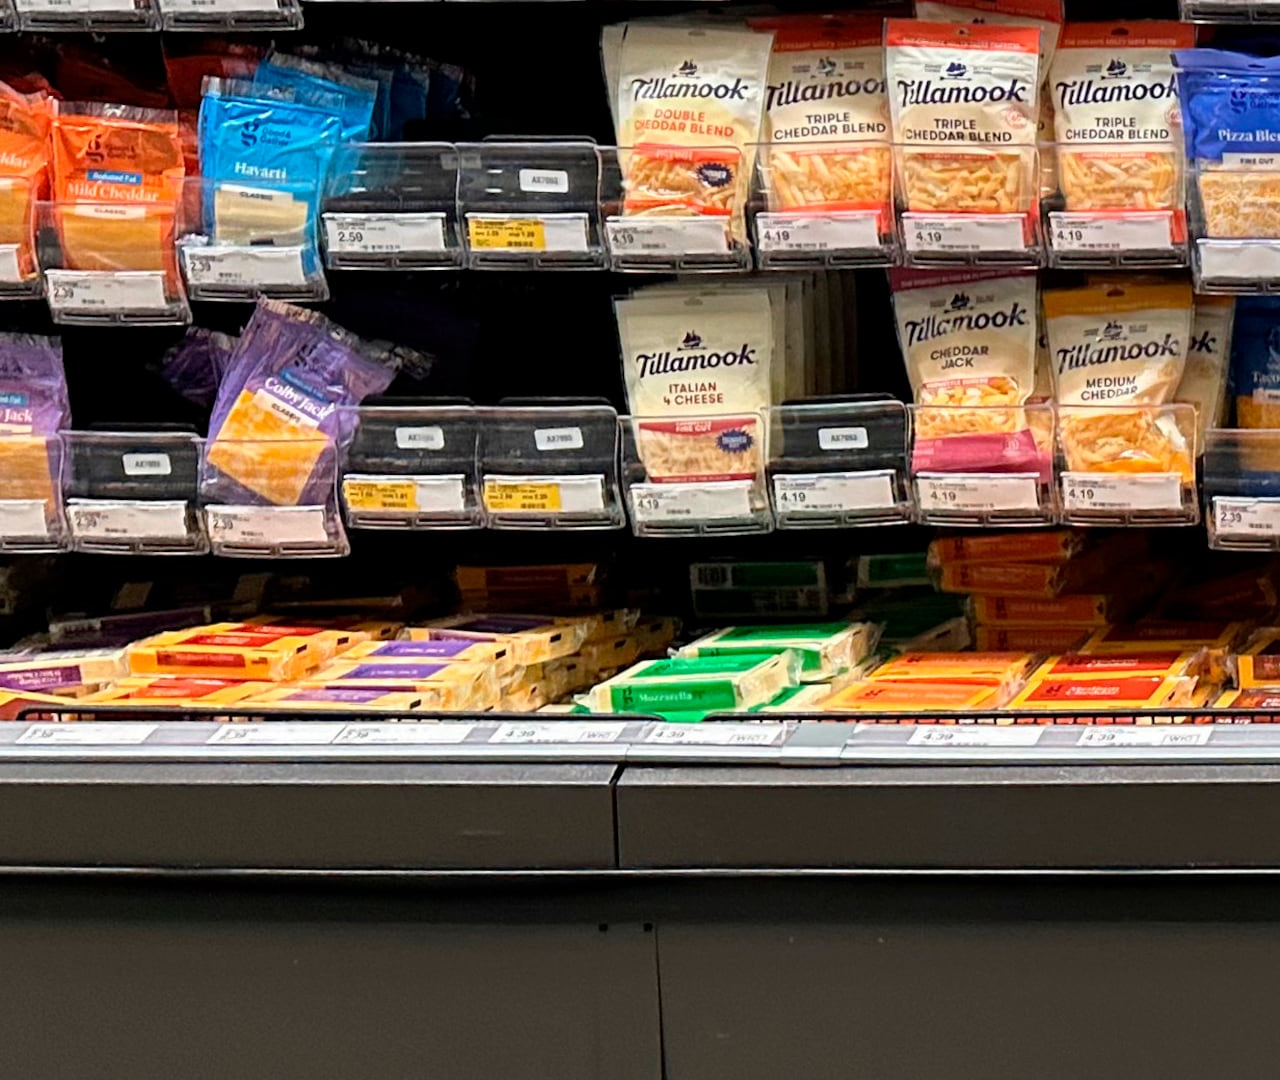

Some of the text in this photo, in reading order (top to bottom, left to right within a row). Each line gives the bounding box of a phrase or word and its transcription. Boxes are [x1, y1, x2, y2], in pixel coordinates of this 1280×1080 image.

[632, 77, 748, 101] Tillamook
[897, 79, 1026, 108] Tillamook
[1056, 76, 1179, 106] Tillamook
[653, 109, 706, 122] DOUBLE
[805, 112, 850, 125] TRIPLE
[935, 118, 976, 130] TRIPLE
[1094, 117, 1137, 129] TRIPLE
[773, 122, 887, 139] CHEDDAR BLEND
[905, 129, 1012, 143] CHEDDAR BLEND
[1066, 127, 1169, 140] CHEDDAR BLEND
[1217, 129, 1253, 144] Pizza
[235, 161, 288, 180] Havarti
[68, 183, 160, 202] Mild Cheddar
[337, 230, 364, 244] 2.59
[916, 229, 942, 243] 4.19
[1056, 229, 1082, 242] 4.19
[905, 303, 1027, 345] Tillamook
[930, 345, 989, 362] CHEDDAR
[1056, 334, 1180, 374] Tillamook
[636, 345, 757, 379] Tillamook
[941, 357, 975, 370] JACK
[668, 382, 717, 395] ITALIAN
[1086, 376, 1137, 389] MEDIUM
[264, 377, 334, 420] Colby Jack
[1081, 385, 1139, 401] CHEDDAR
[3, 407, 33, 423] Jack
[931, 490, 956, 503] 4.19
[1069, 488, 1094, 501] 4.19
[639, 691, 692, 703] Mozzarella
[505, 728, 535, 739] 4.39
[1085, 732, 1116, 743] 4.39
